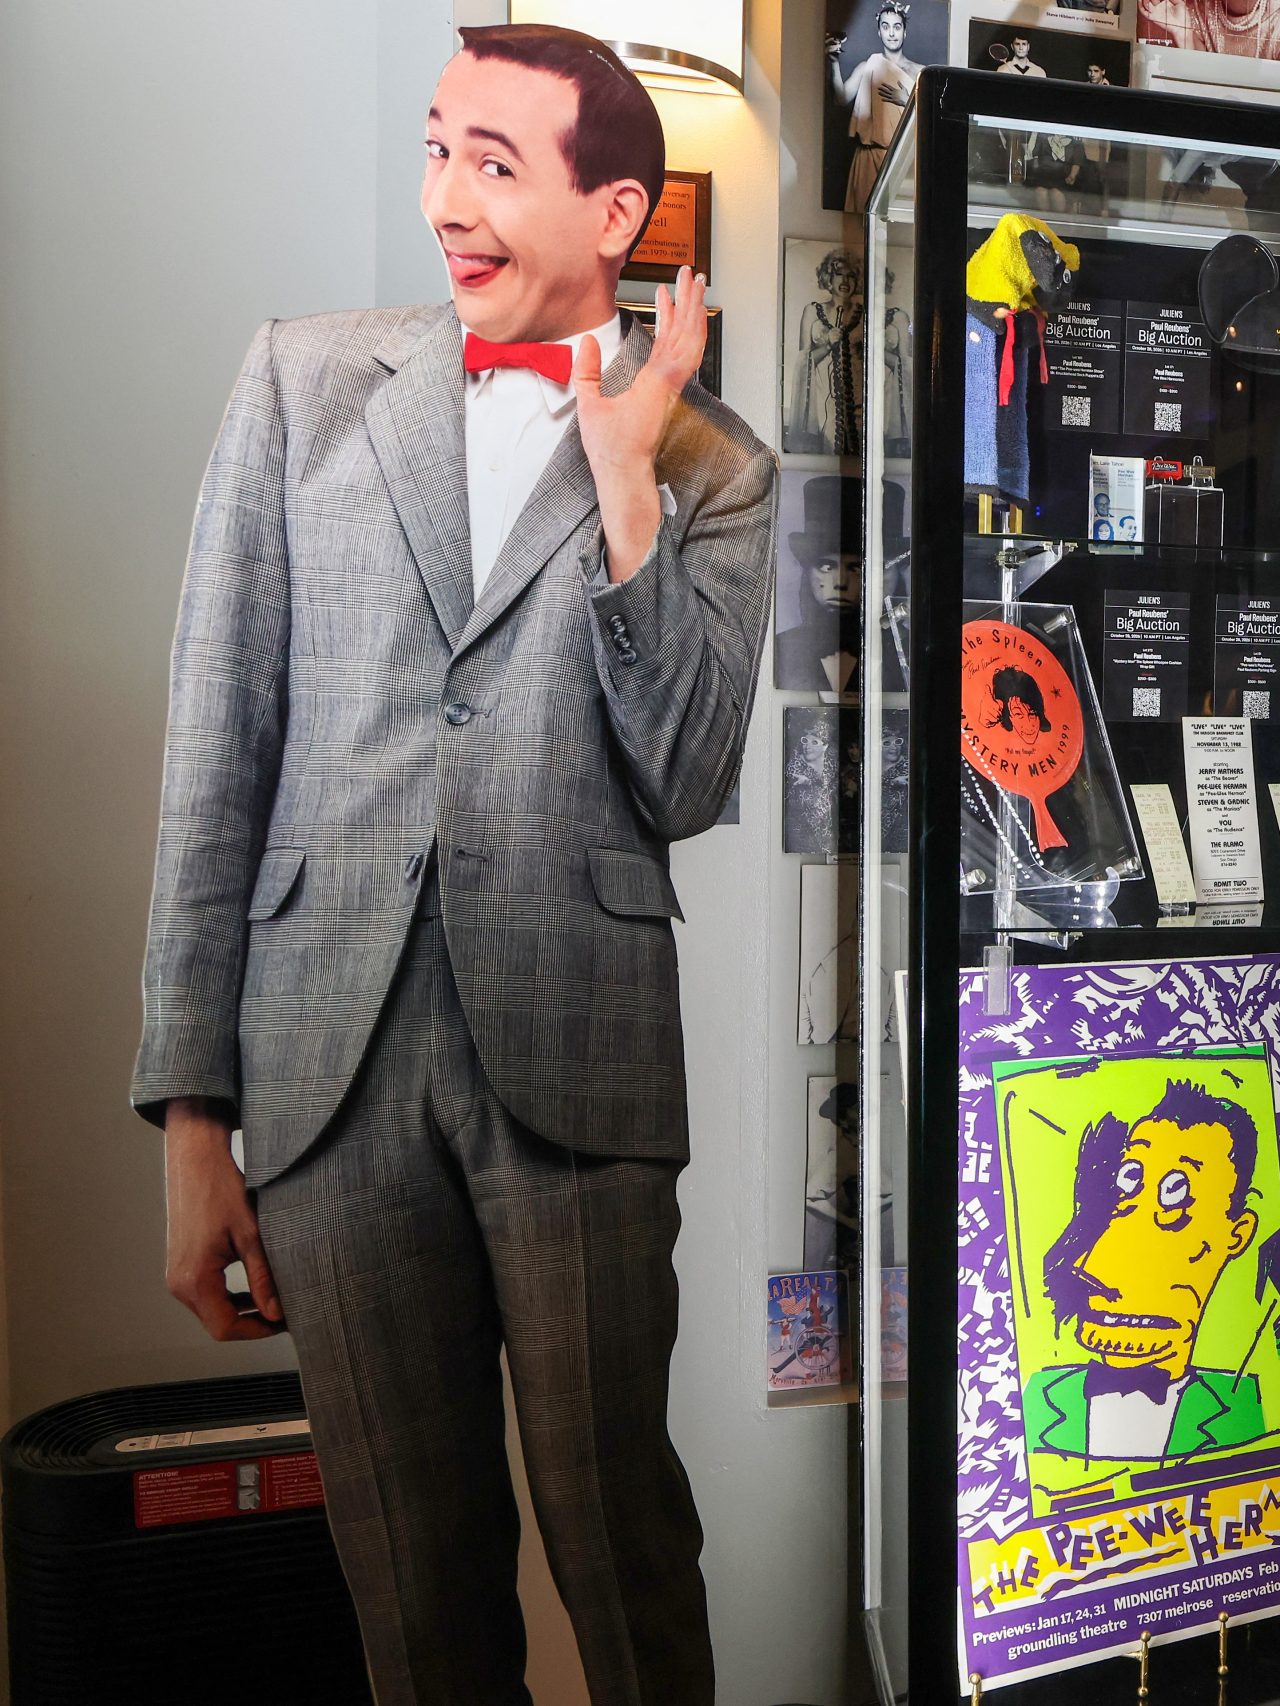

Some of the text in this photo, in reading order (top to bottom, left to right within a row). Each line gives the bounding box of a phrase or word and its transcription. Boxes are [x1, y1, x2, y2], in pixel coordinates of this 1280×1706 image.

[1067, 302, 1091, 312] JULIEN'S
[1159, 308, 1183, 319] JULIEN'S
[1058, 314, 1100, 326] Paul Reubens'
[1045, 323, 1111, 340] Big Auction
[1150, 321, 1191, 333] Paul Reubens'
[1138, 329, 1202, 347] Big Auction
[1137, 596, 1161, 605] JULIEN'S
[1247, 600, 1271, 609] JULIEN'S
[1128, 608, 1169, 619] Paul Reubens'
[1239, 612, 1279, 623] Paul Reubens'
[1116, 617, 1180, 632] Big Auction
[1227, 621, 1245, 636] Big
[991, 628, 1044, 668] Spleen
[1028, 753, 1057, 778] MEN
[1058, 723, 1071, 754] 1999
[1223, 840, 1244, 848] ALAMO
[1213, 880, 1233, 888] ADMIT
[972, 1555, 1040, 1614] THE
[1046, 1495, 1212, 1571] PEE-WEE
[972, 1621, 1036, 1647] Previews:
[1037, 1614, 1059, 1631] Jan
[1113, 1583, 1180, 1612] MIDNIGHT
[1182, 1566, 1254, 1595] SATURDAYS
[1258, 1561, 1279, 1577] Feb
[1007, 1630, 1078, 1661] groundling
[1079, 1617, 1128, 1639] theatre
[1137, 1609, 1163, 1626] 7307
[1164, 1597, 1214, 1620] melrose
